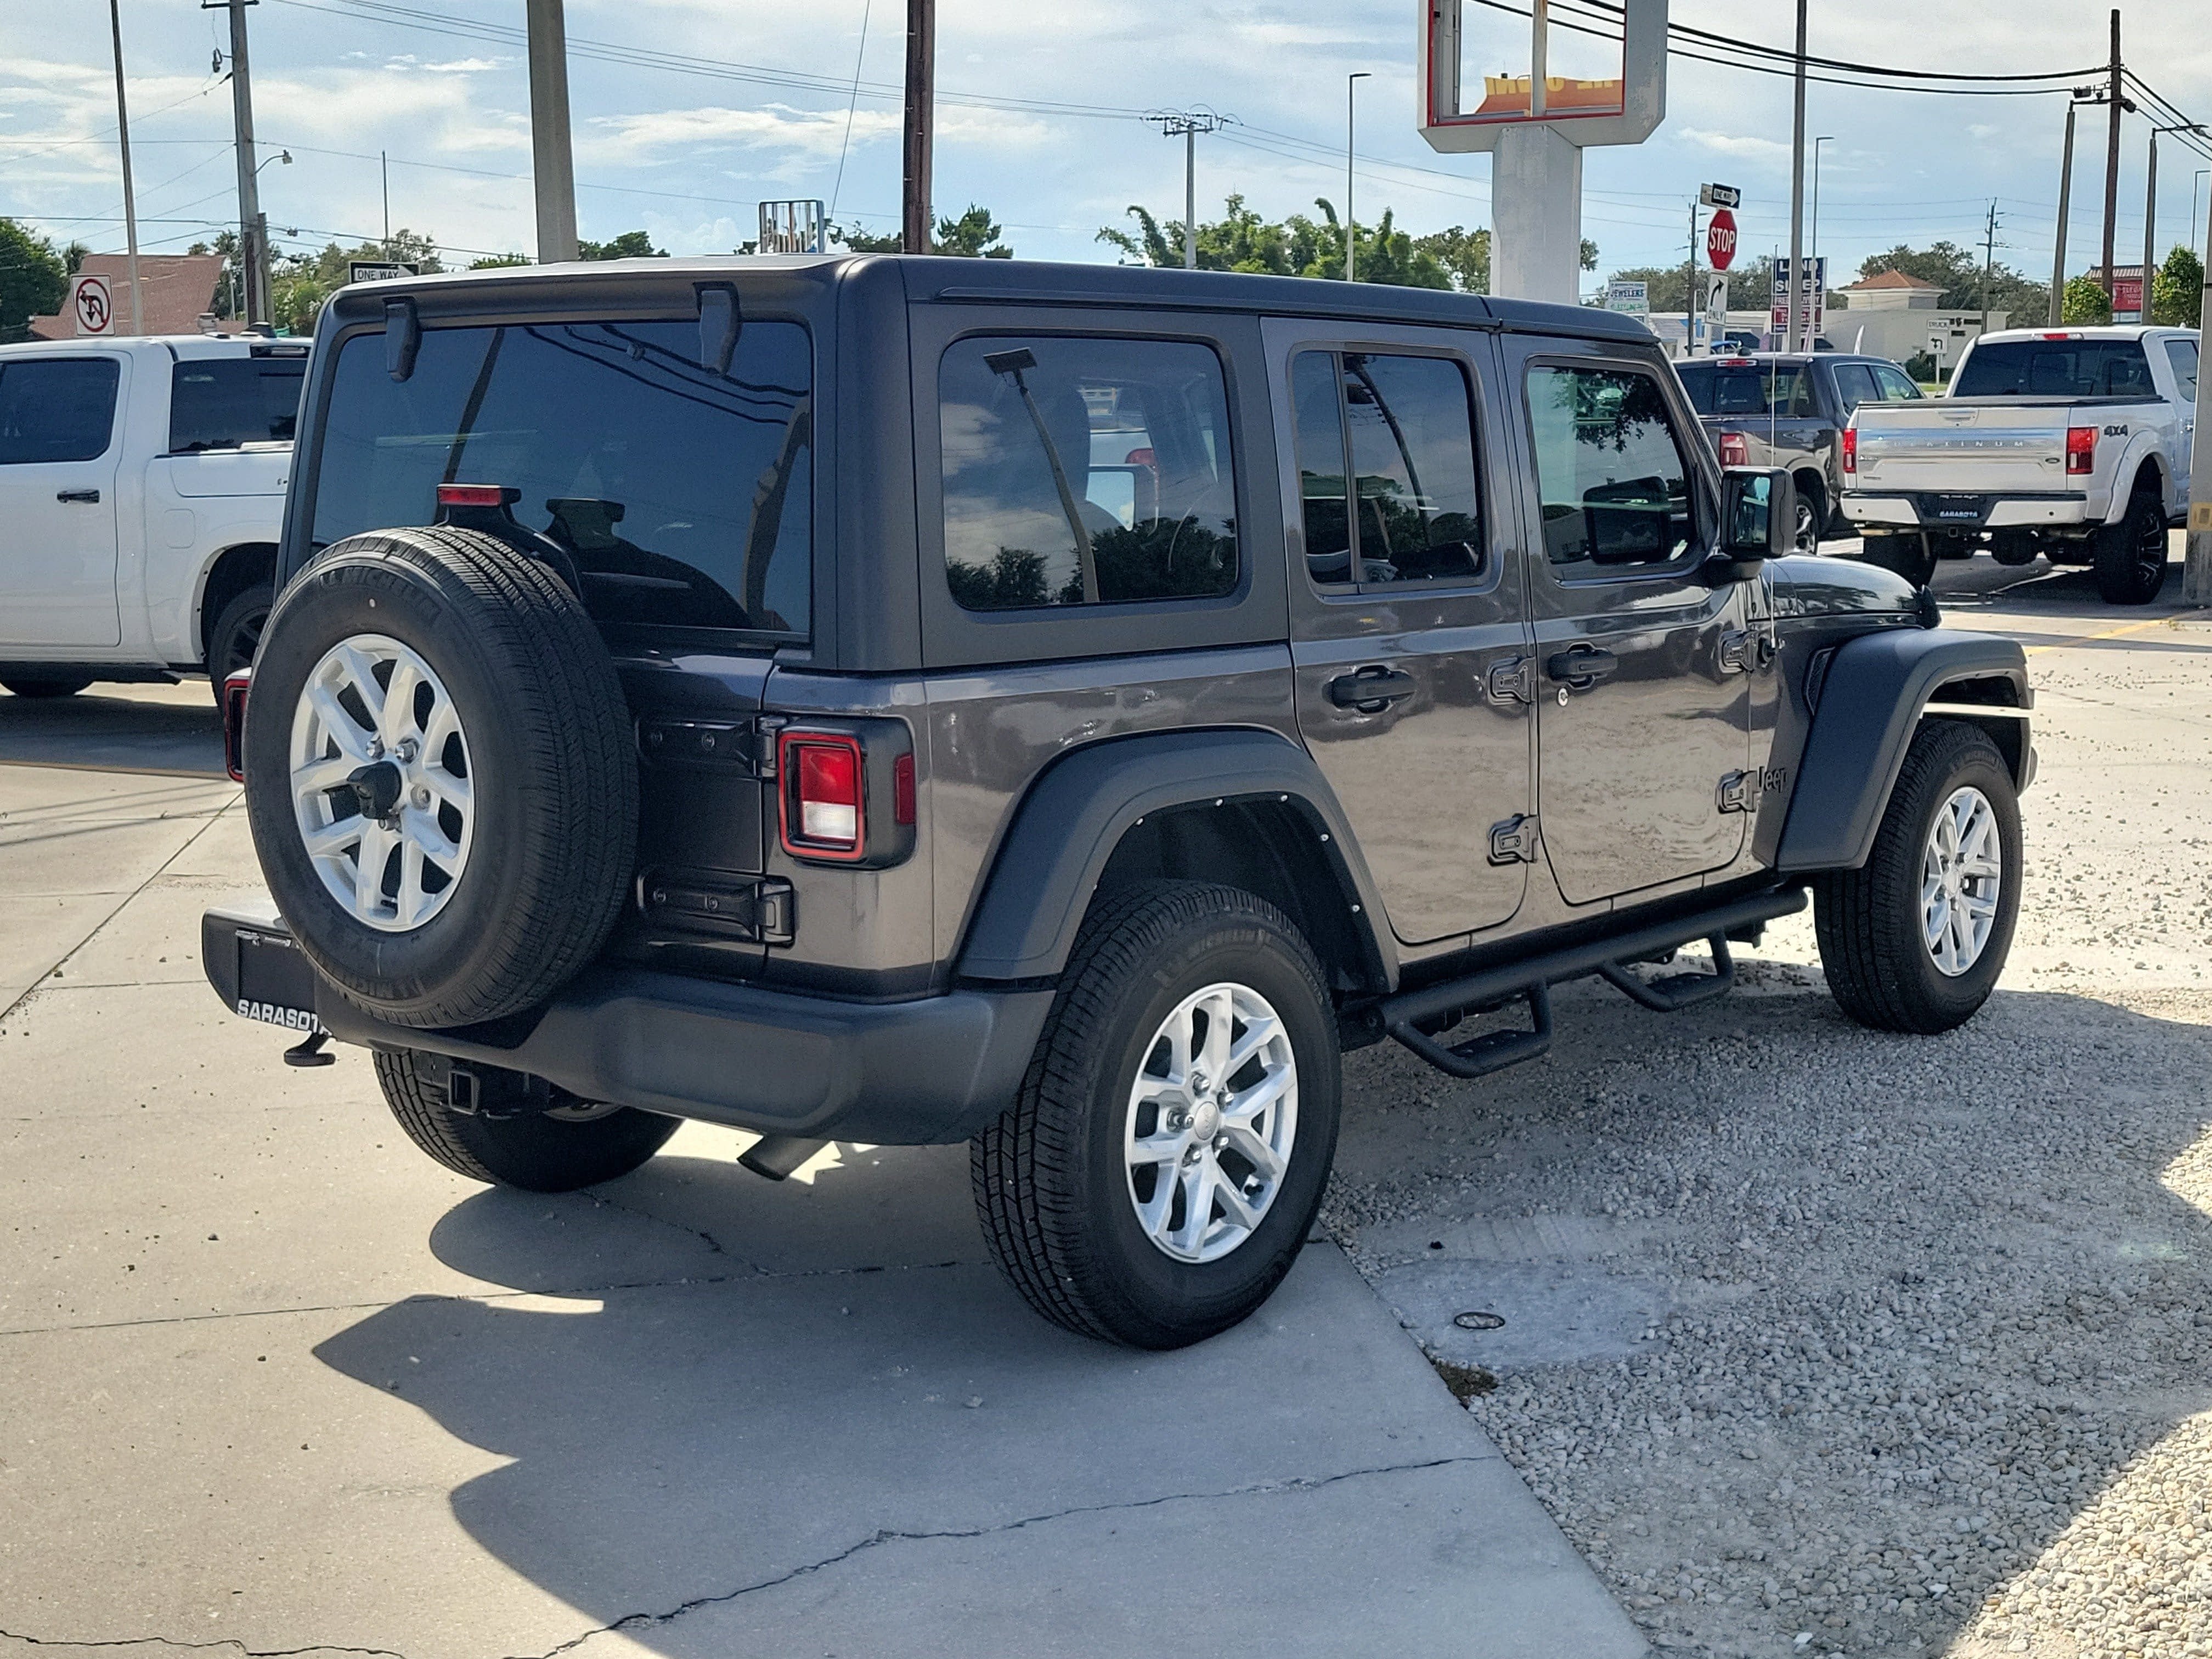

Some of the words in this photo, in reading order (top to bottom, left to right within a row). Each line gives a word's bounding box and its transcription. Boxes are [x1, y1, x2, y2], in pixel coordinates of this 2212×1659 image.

[1709, 227, 1735, 252] STOP
[357, 270, 376, 280] ONE
[380, 270, 399, 280] WAY
[1779, 260, 1818, 272] LND
[1758, 766, 1786, 794] Jeep
